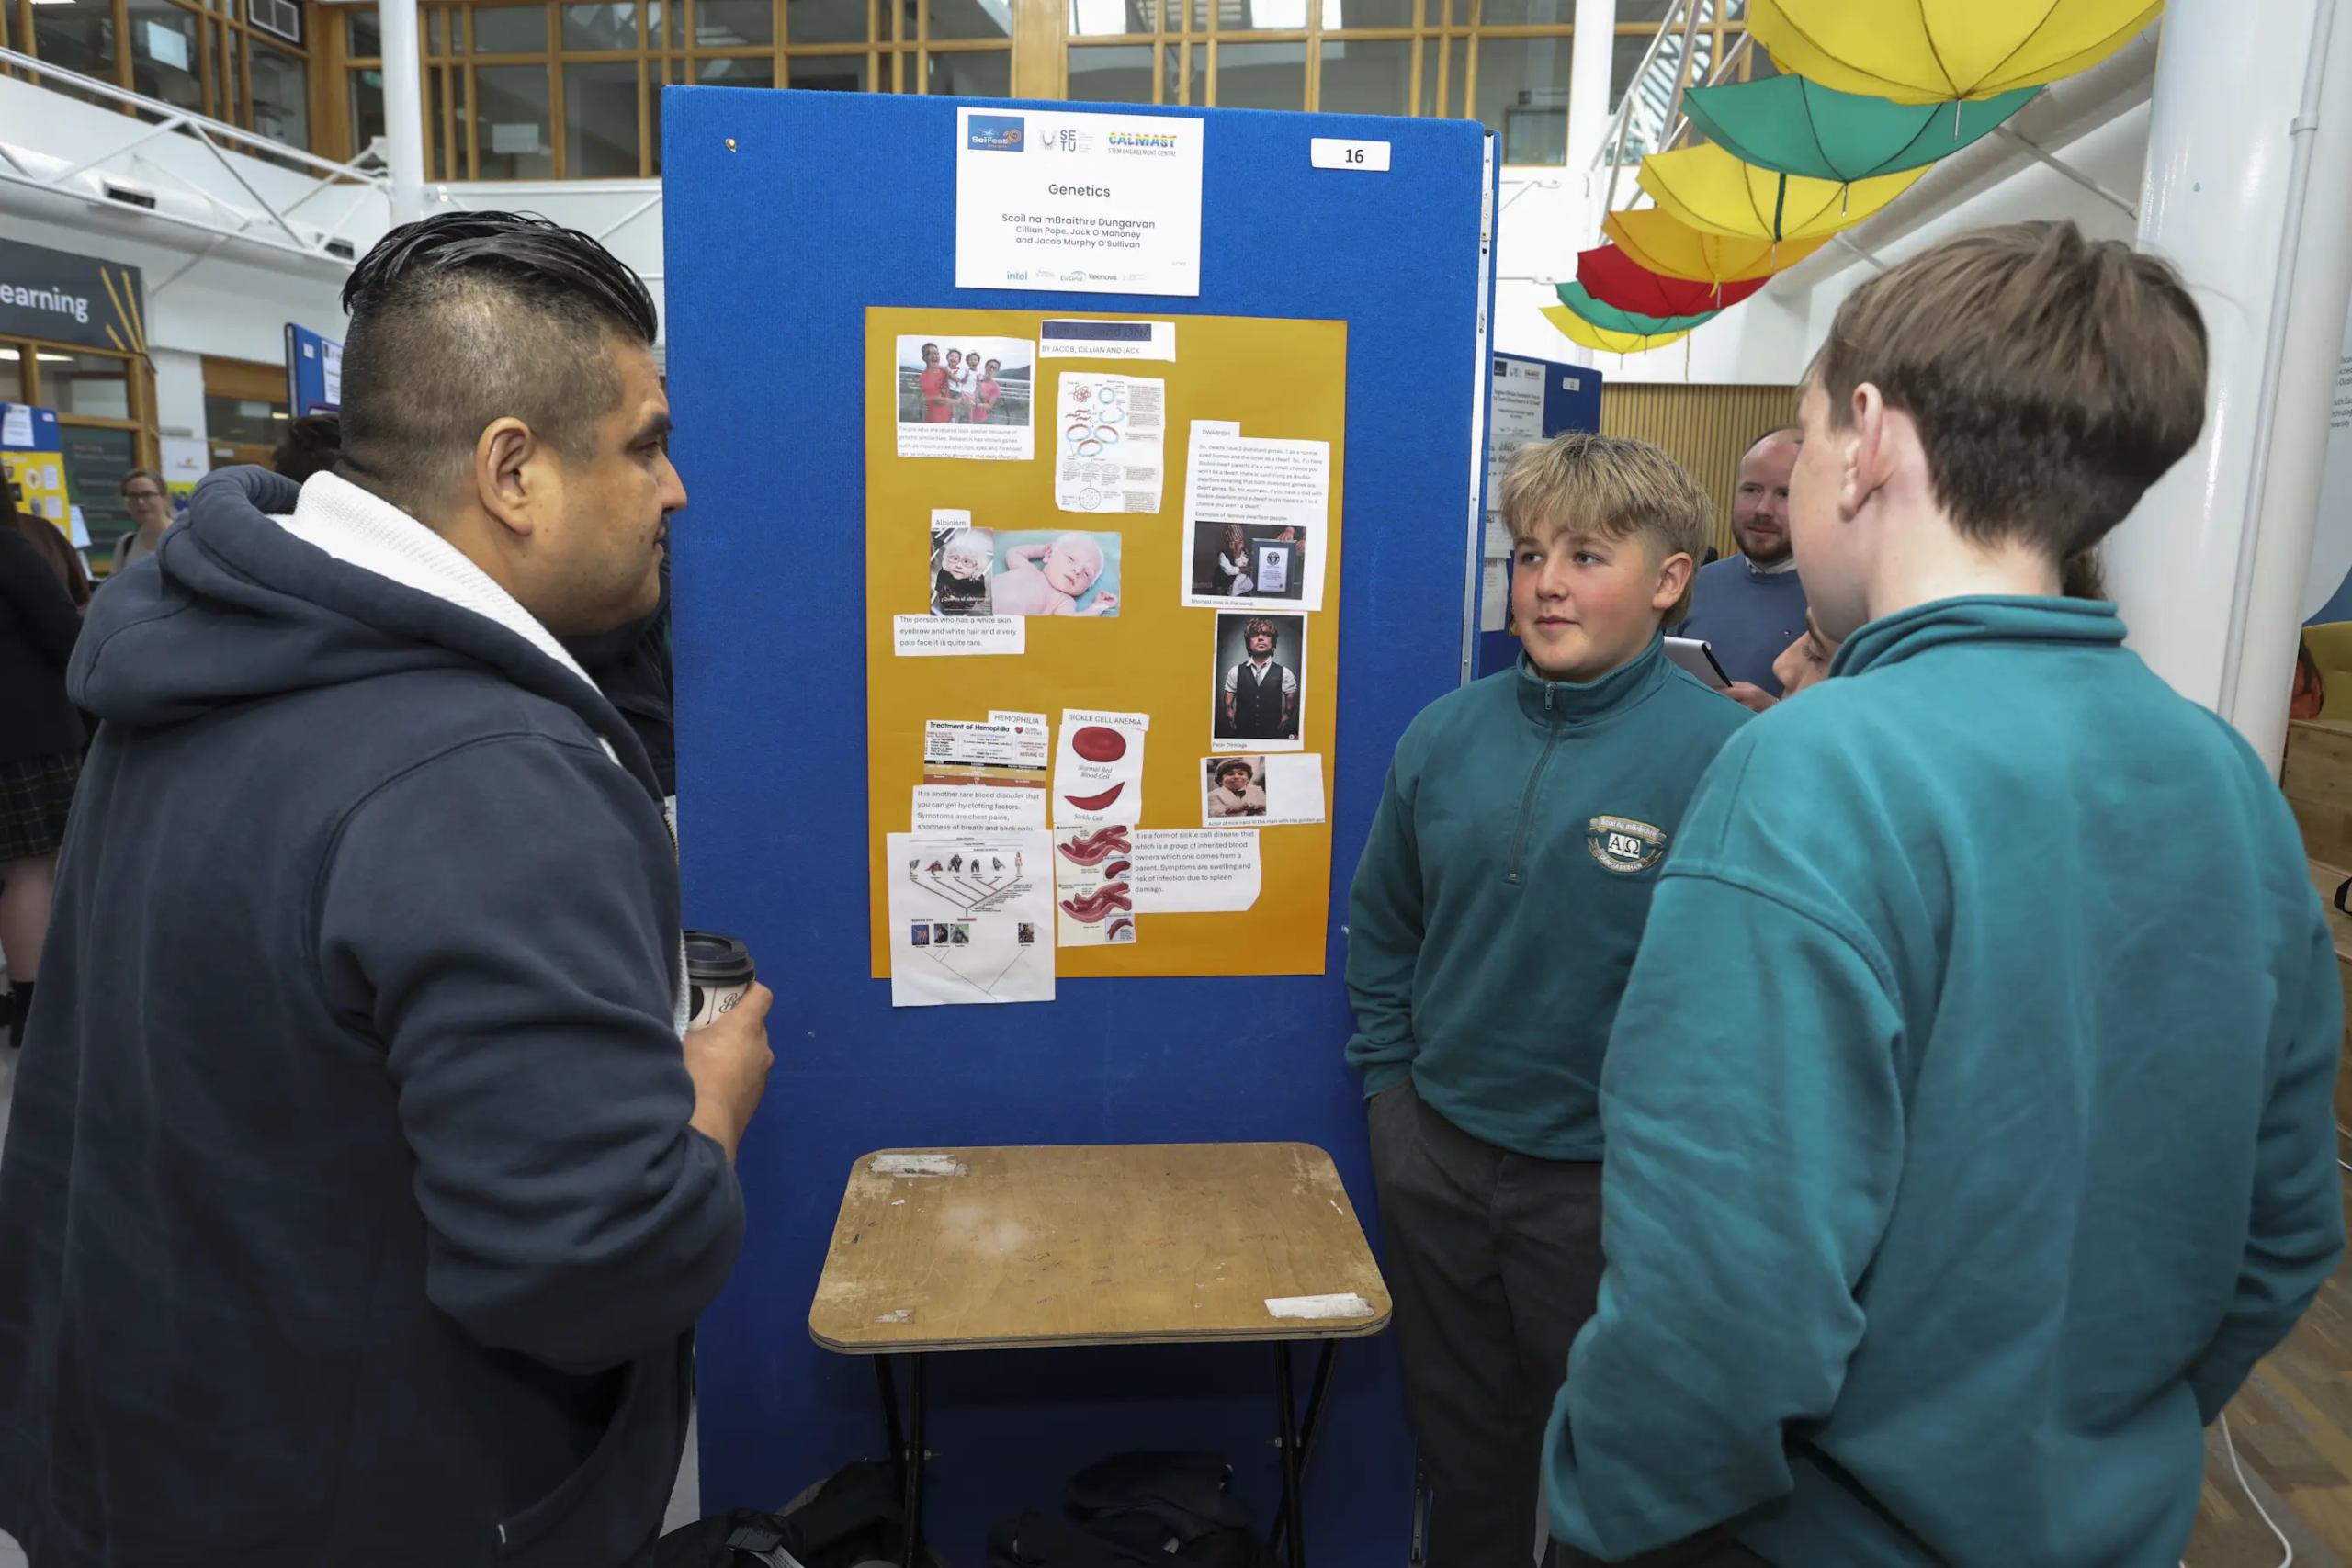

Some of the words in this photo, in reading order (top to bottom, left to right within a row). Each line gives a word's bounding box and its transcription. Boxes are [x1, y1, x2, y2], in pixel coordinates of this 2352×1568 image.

[1060, 130, 1076, 141] SE
[1108, 132, 1177, 147] CALMAST
[1060, 141, 1076, 152] TU
[1345, 149, 1363, 163] 16
[1048, 184, 1110, 197] Genetics
[1001, 213, 1025, 222] Scoil
[1045, 216, 1095, 226] mBraithre
[1098, 218, 1155, 229] Dungarvan
[1045, 228, 1069, 237] Pope,
[1093, 230, 1141, 239] O'Mahoney
[1035, 237, 1061, 245] Jacob
[1064, 239, 1096, 248] Murphy
[1098, 240, 1140, 248] O'Sullivan
[1007, 271, 1027, 280] intel
[0, 284, 89, 323] earning
[994, 715, 1039, 724] HEMOPHILIA
[1069, 714, 1093, 722] SICKLE
[1095, 716, 1113, 724] CELL
[1114, 717, 1141, 726] ANEMIA
[918, 812, 954, 820] Symptoms
